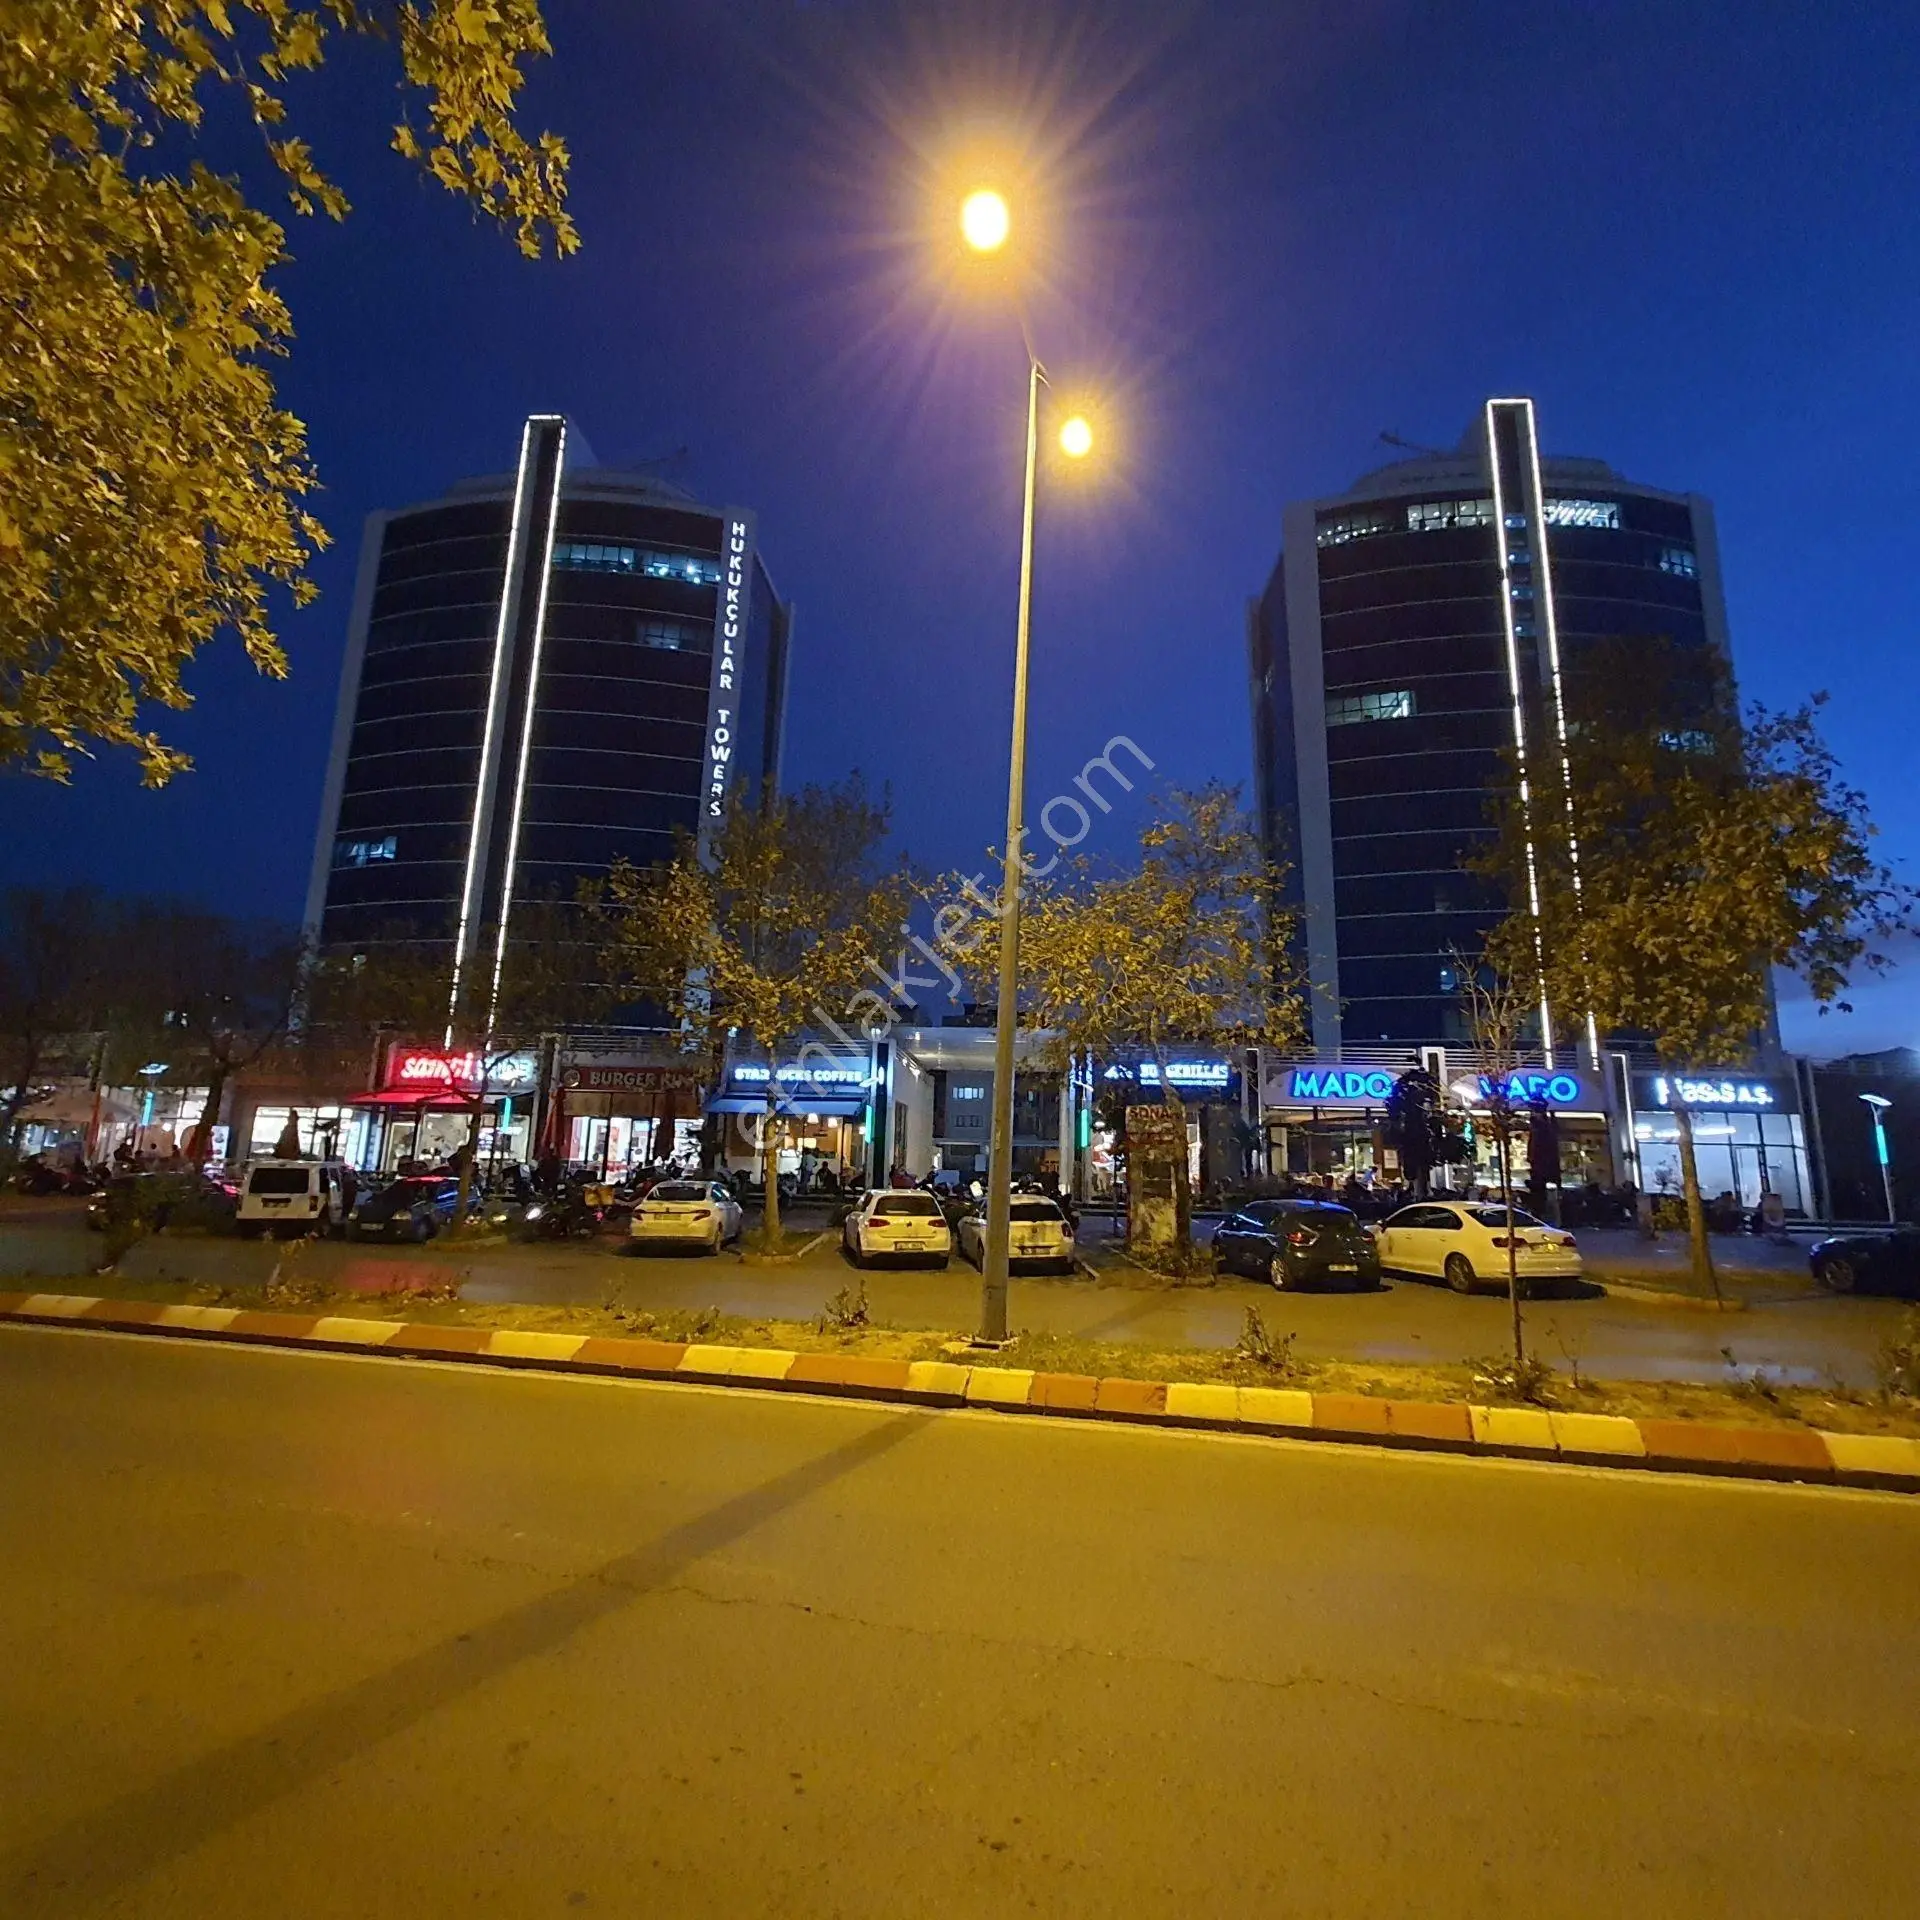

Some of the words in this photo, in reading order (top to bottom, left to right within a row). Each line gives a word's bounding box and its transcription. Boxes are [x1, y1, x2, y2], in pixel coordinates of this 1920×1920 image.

[719, 521, 746, 690] HUKUKÇULAR
[709, 709, 732, 817] TOWERS
[589, 1071, 657, 1087] BURGER
[734, 1068, 812, 1081] STARUCKS
[813, 1069, 864, 1082] COFFEE
[1292, 1071, 1393, 1099] MADO
